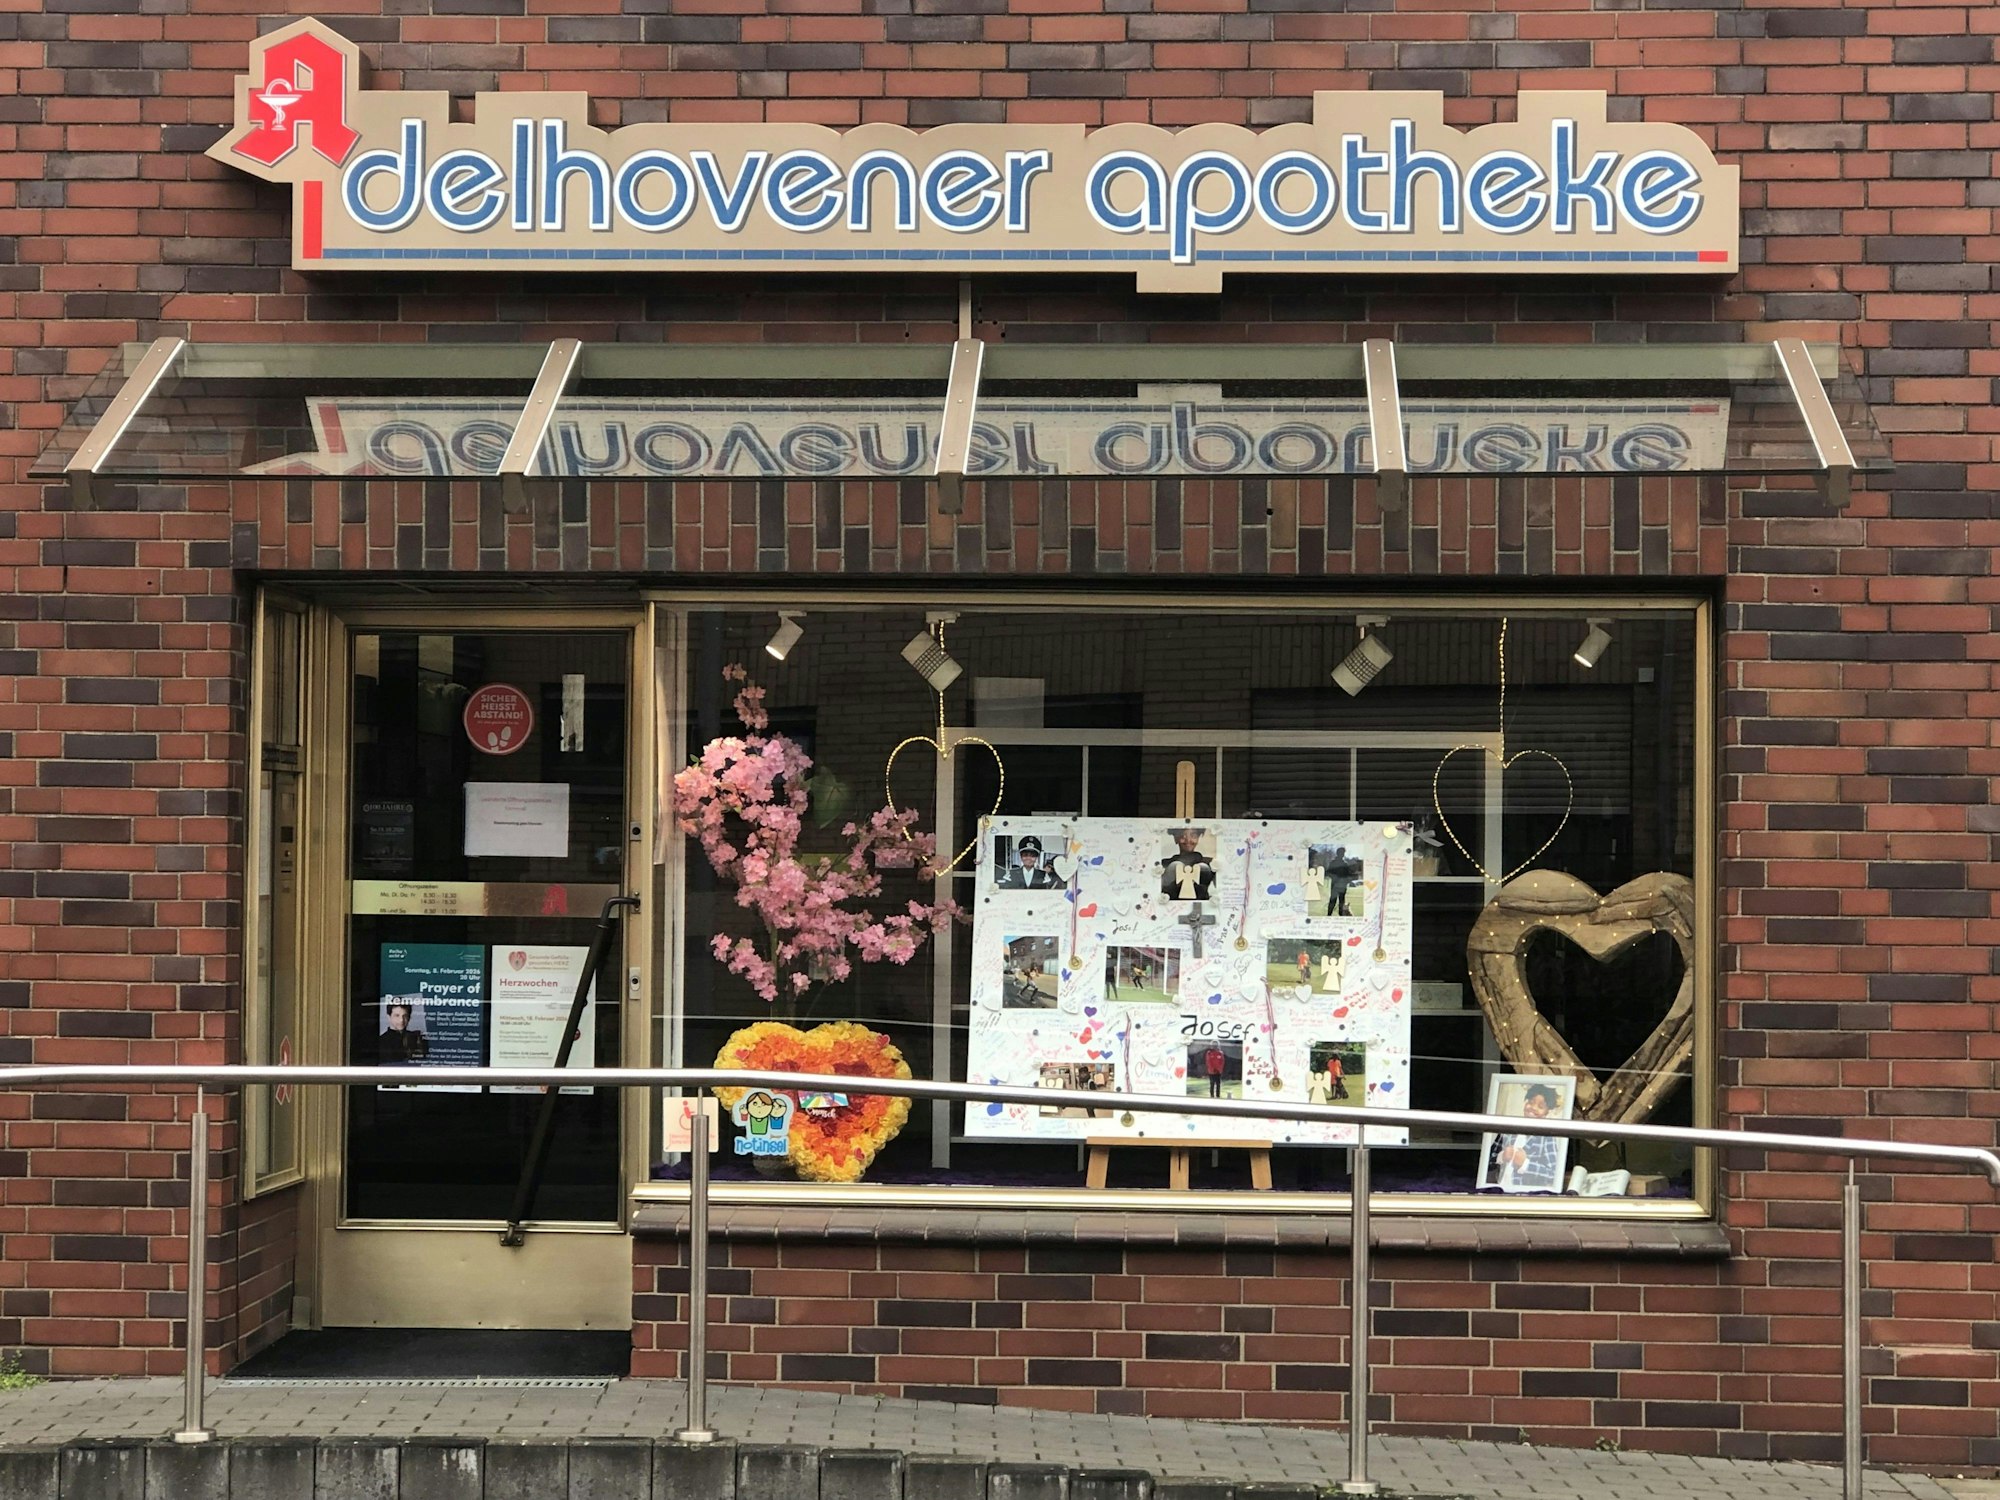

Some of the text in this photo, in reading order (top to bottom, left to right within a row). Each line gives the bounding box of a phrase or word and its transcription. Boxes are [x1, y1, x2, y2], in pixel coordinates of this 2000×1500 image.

[342, 118, 1701, 265] delhovener apotheke
[480, 694, 518, 703] SICHER
[480, 702, 517, 711] HEISST
[473, 710, 523, 720] ABSTAND!
[404, 966, 431, 975] Sonntag,
[465, 967, 480, 975] 2026
[419, 981, 480, 996] Prayer of
[499, 978, 558, 988] Herzwochen
[385, 993, 480, 1007] Remembrance
[1180, 1014, 1255, 1040] Josef
[736, 1137, 787, 1153] notinsel
